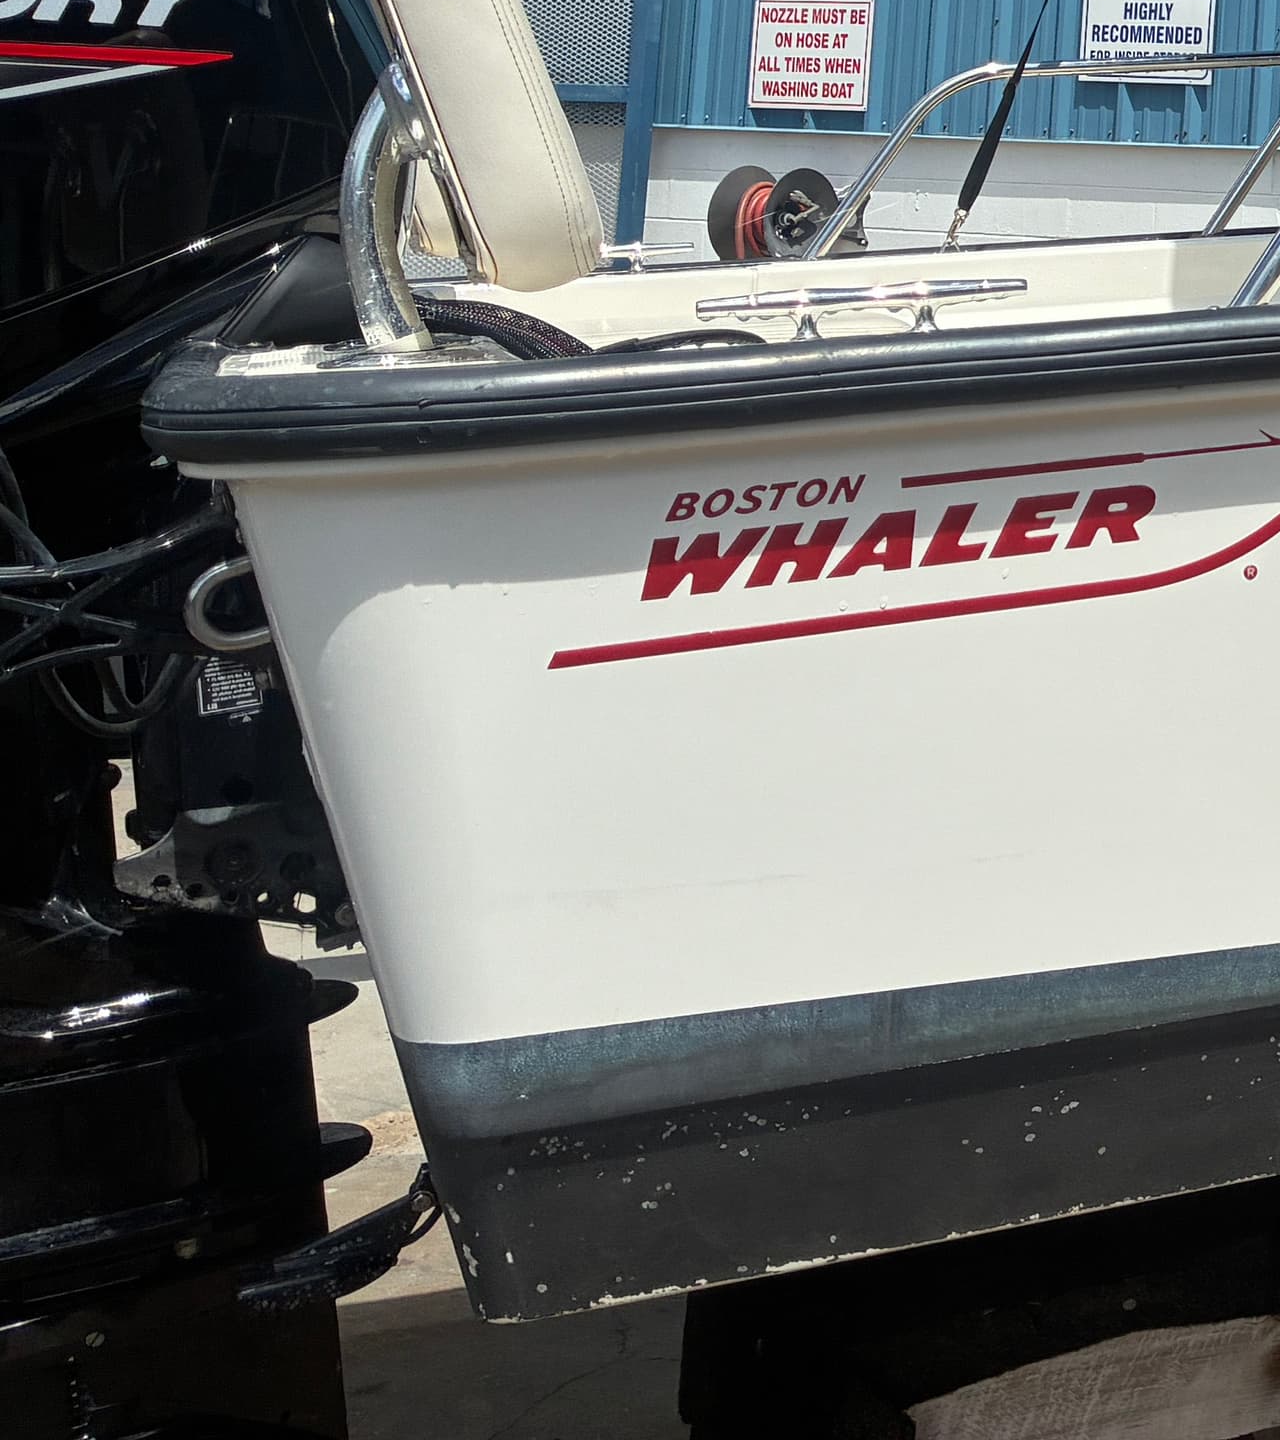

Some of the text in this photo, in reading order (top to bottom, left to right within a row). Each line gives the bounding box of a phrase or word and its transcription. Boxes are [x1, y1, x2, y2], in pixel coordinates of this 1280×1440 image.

[761, 8, 866, 25] NOZZLE MUST BE
[1123, 2, 1174, 21] HIGHLY
[775, 32, 848, 49] ON HOSE AT
[1092, 24, 1203, 45] RECOMMENDED
[758, 56, 861, 74] ALL TIMES WHEN
[762, 81, 854, 98] WASHING BOAT
[665, 474, 866, 522] BOSTON
[640, 484, 1157, 602] WHALER
